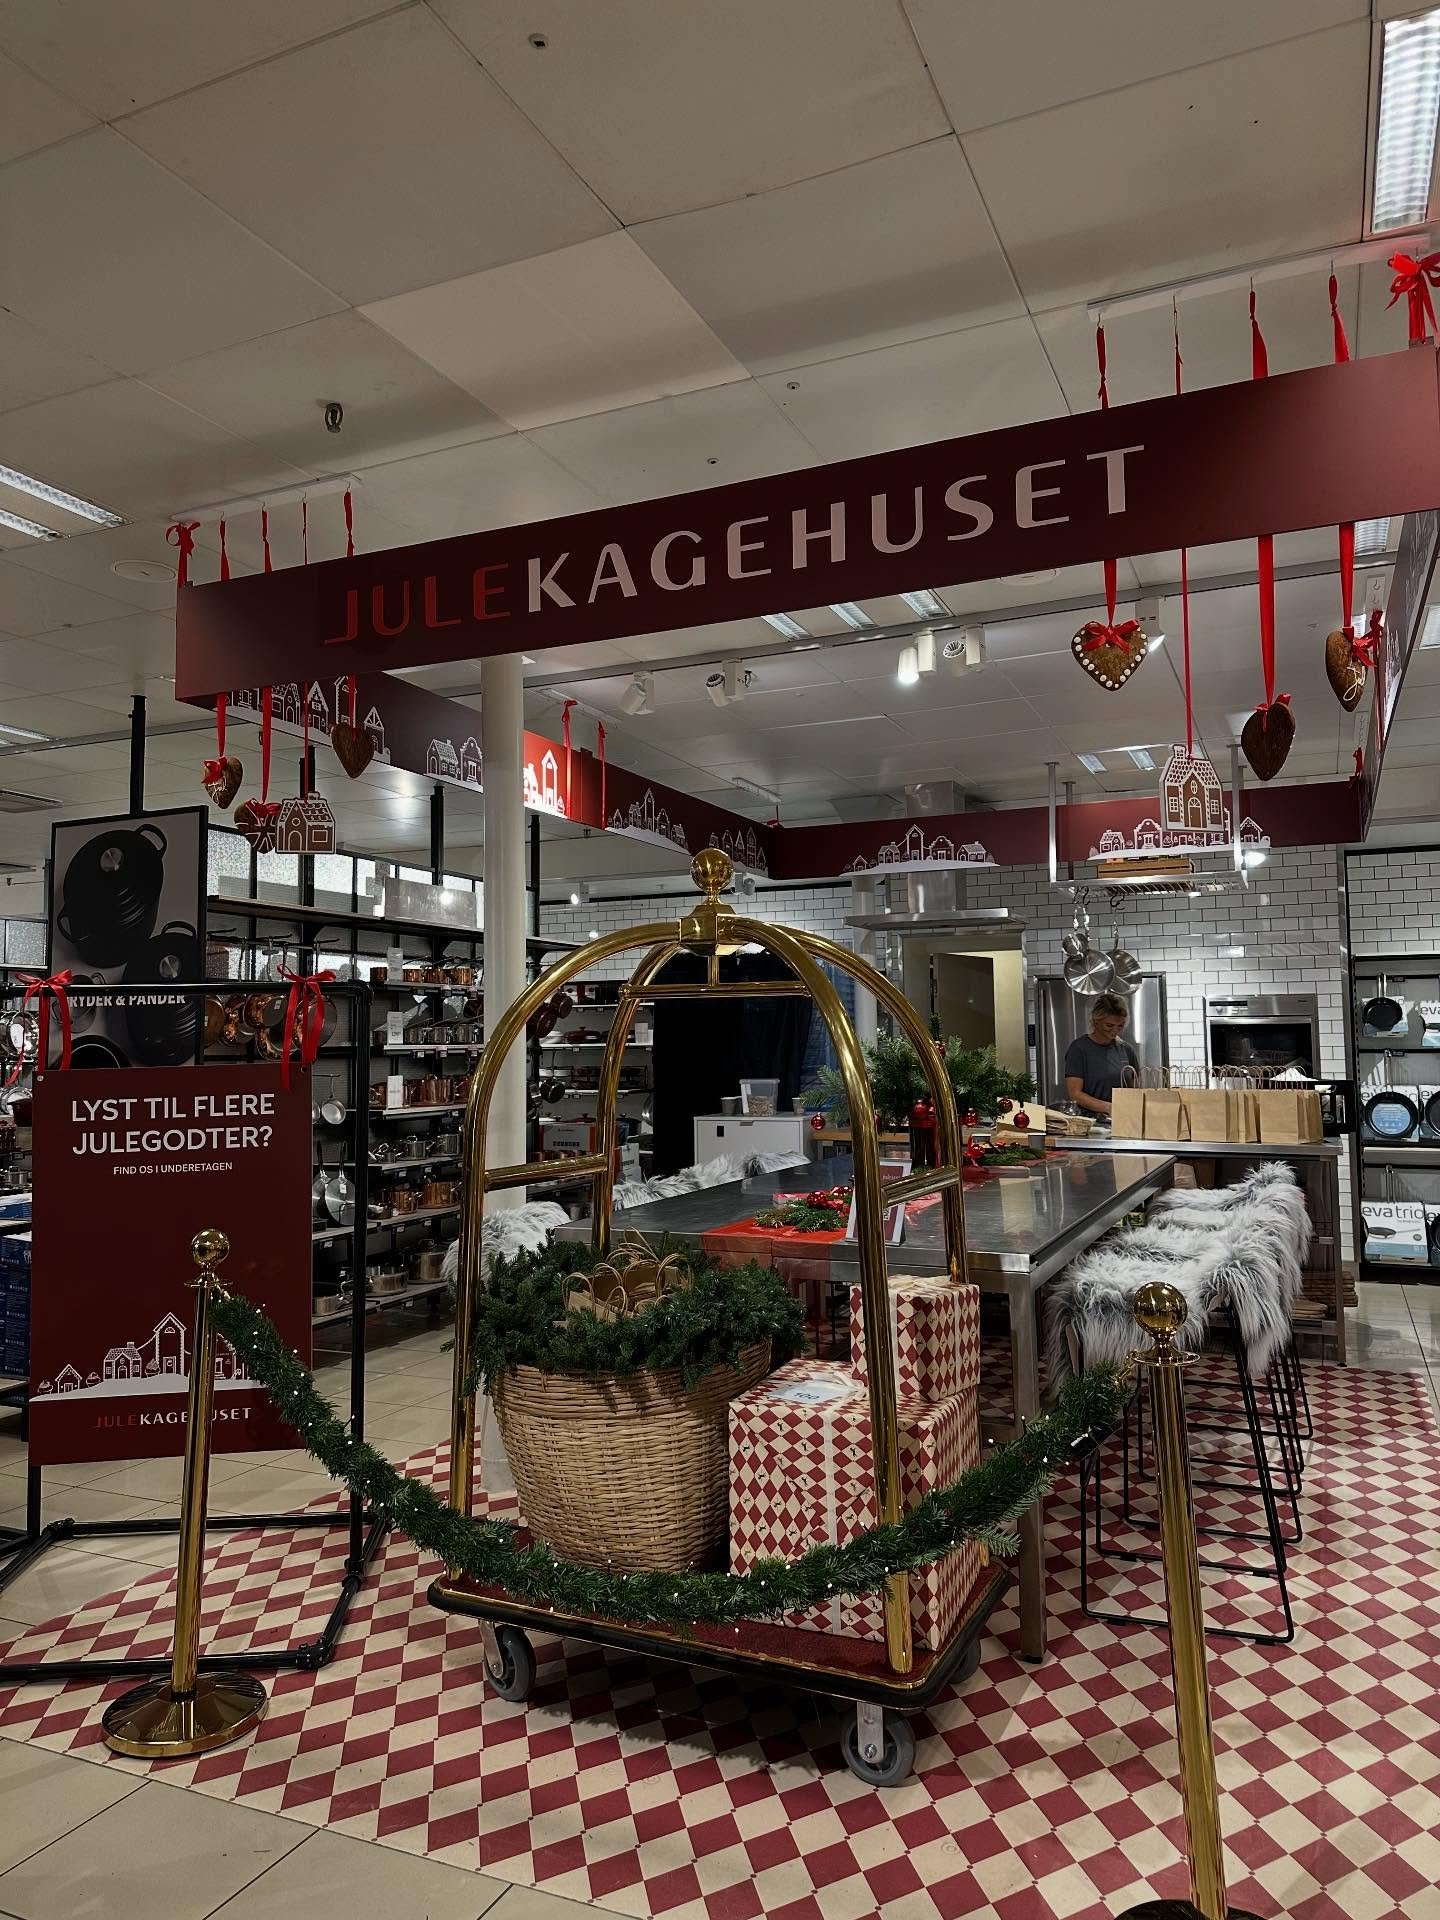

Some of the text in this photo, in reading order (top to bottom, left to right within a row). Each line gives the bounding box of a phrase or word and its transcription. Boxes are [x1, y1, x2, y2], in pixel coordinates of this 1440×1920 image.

[324, 444, 1146, 646] JULEKAGEHUSET
[67, 993, 186, 1008] RYDER & PANDER
[72, 1093, 275, 1122] LYST TIL FLERE
[72, 1125, 273, 1155] JULEGODTER?
[113, 1166, 137, 1175] FIND
[139, 1165, 154, 1174] OS
[160, 1162, 233, 1174] UNDERETAGEN
[94, 1407, 252, 1429] JULEKAGEUSET
